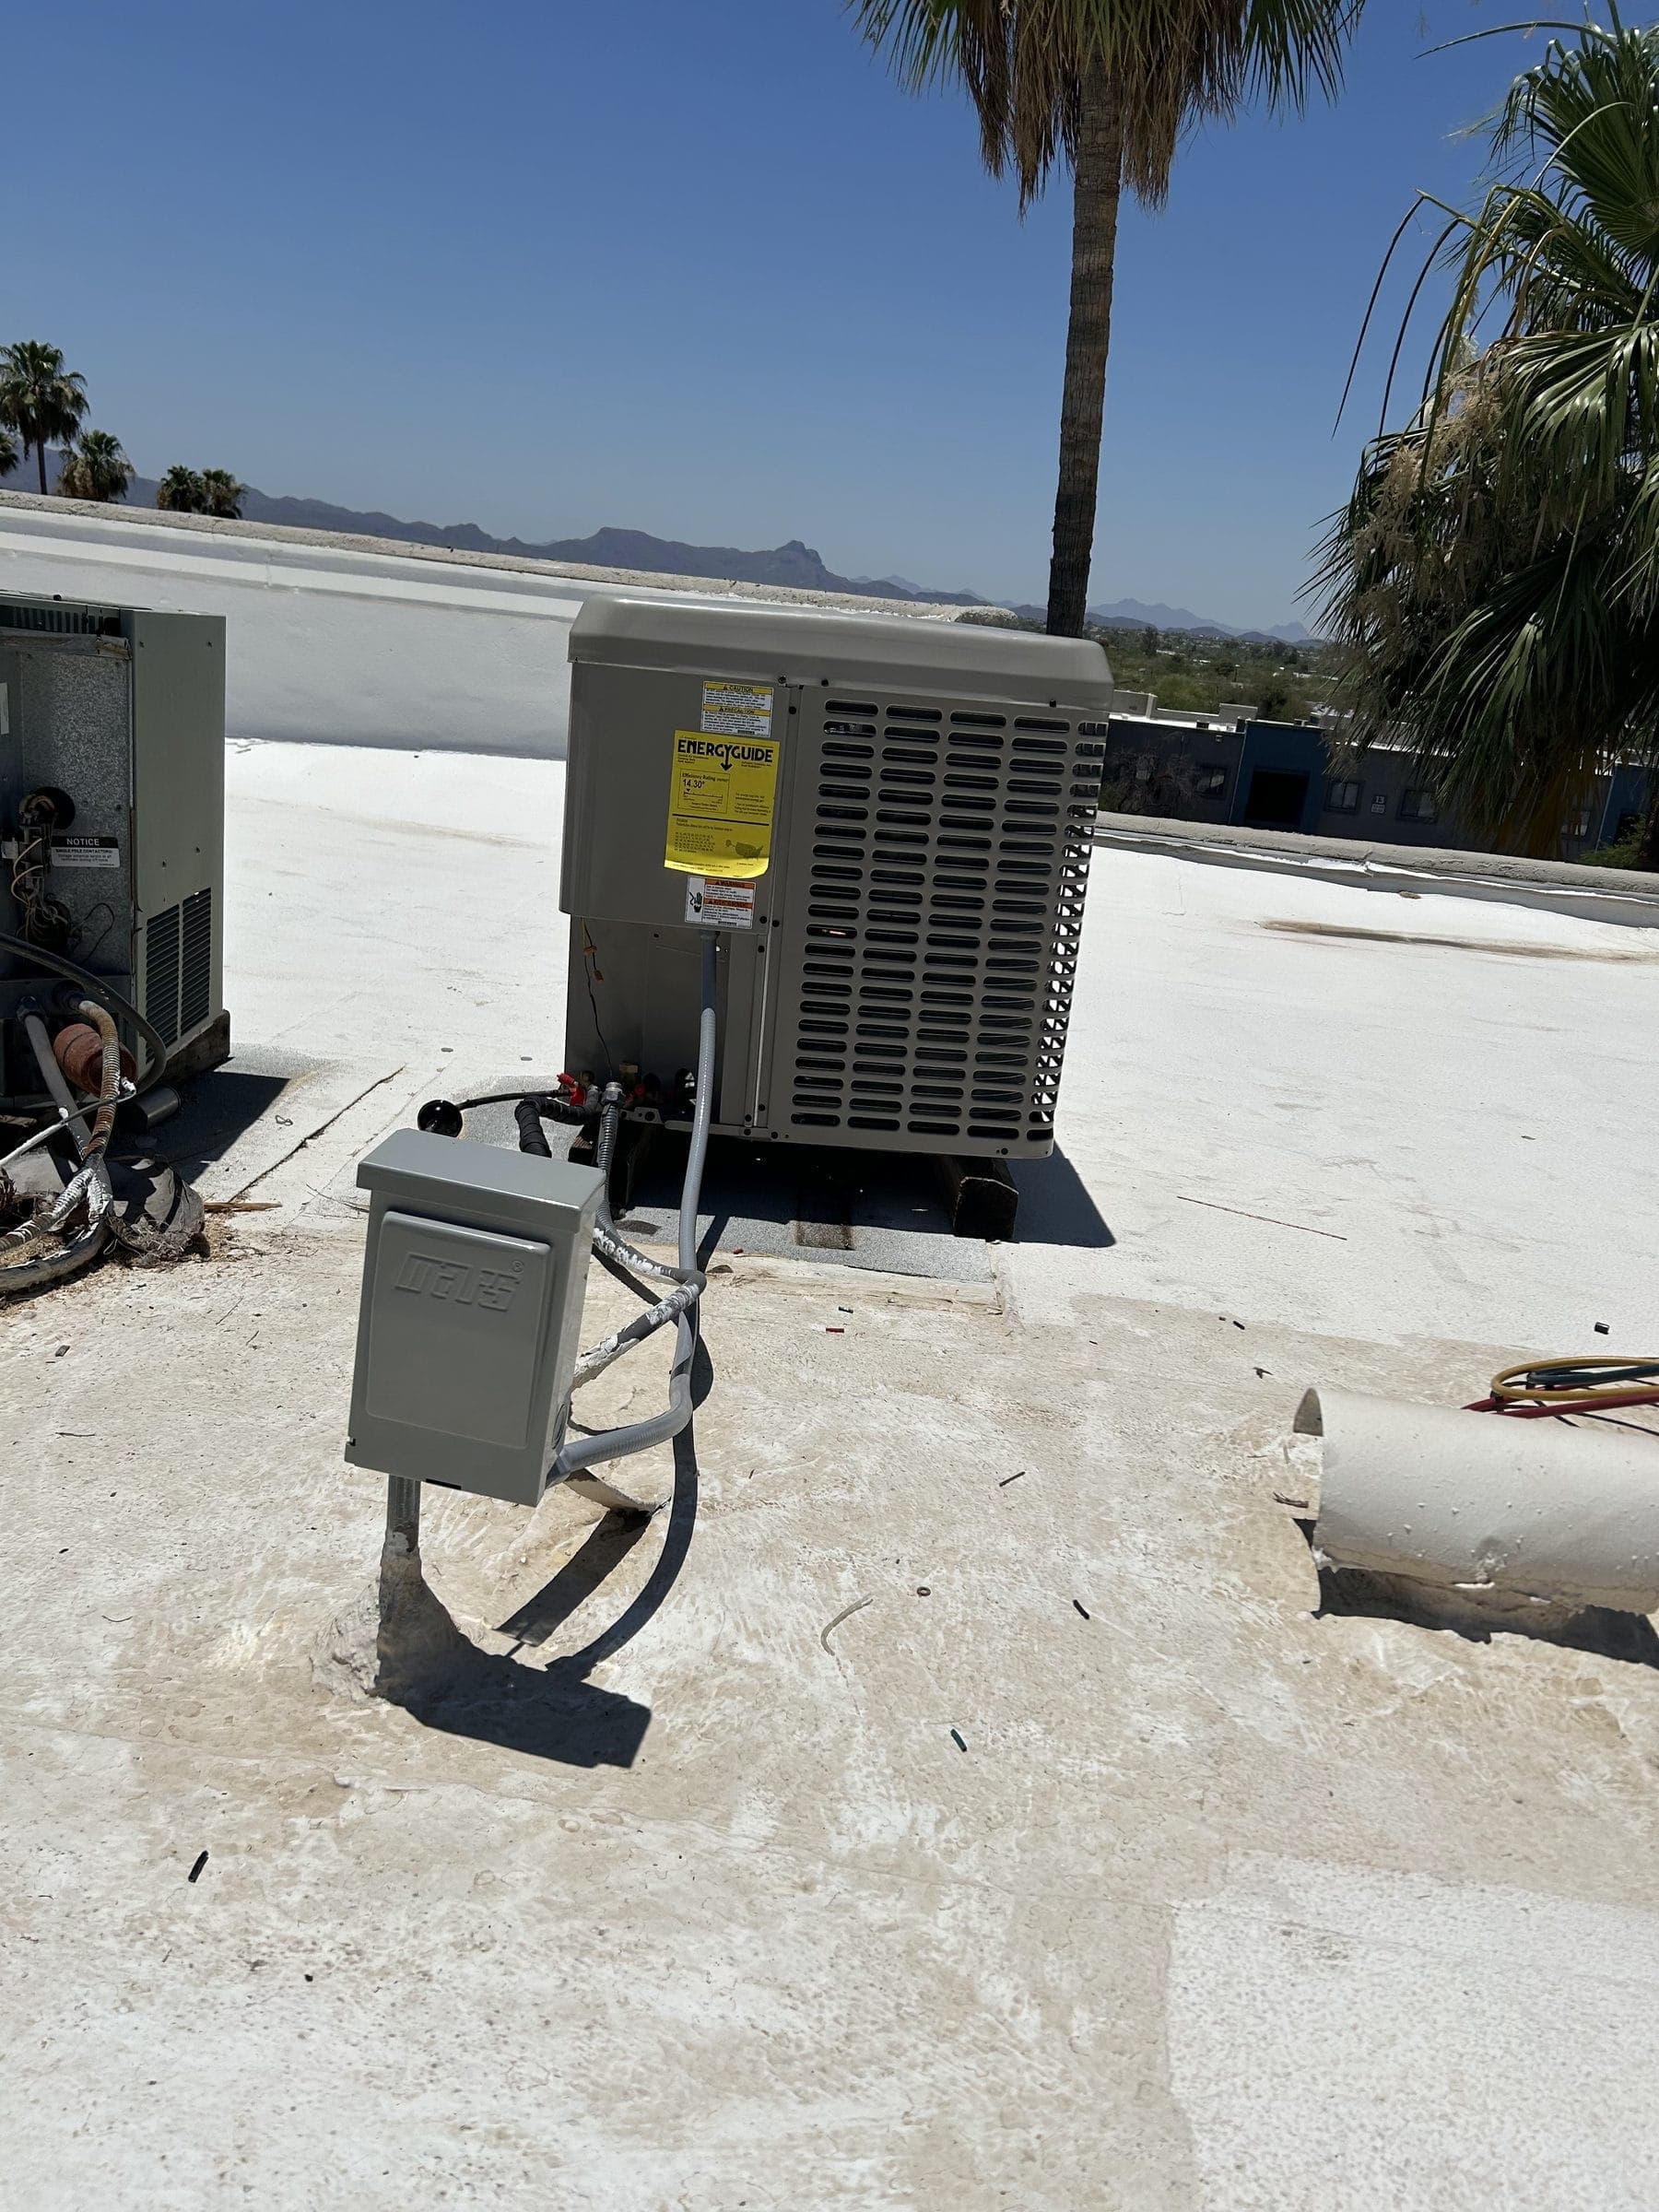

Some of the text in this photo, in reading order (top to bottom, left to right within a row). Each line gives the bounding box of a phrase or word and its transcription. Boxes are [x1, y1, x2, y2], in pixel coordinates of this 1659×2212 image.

[728, 684, 754, 693] CAUTION
[677, 739, 774, 763] ENERGYGUIDE
[66, 838, 100, 846] NOTICE
